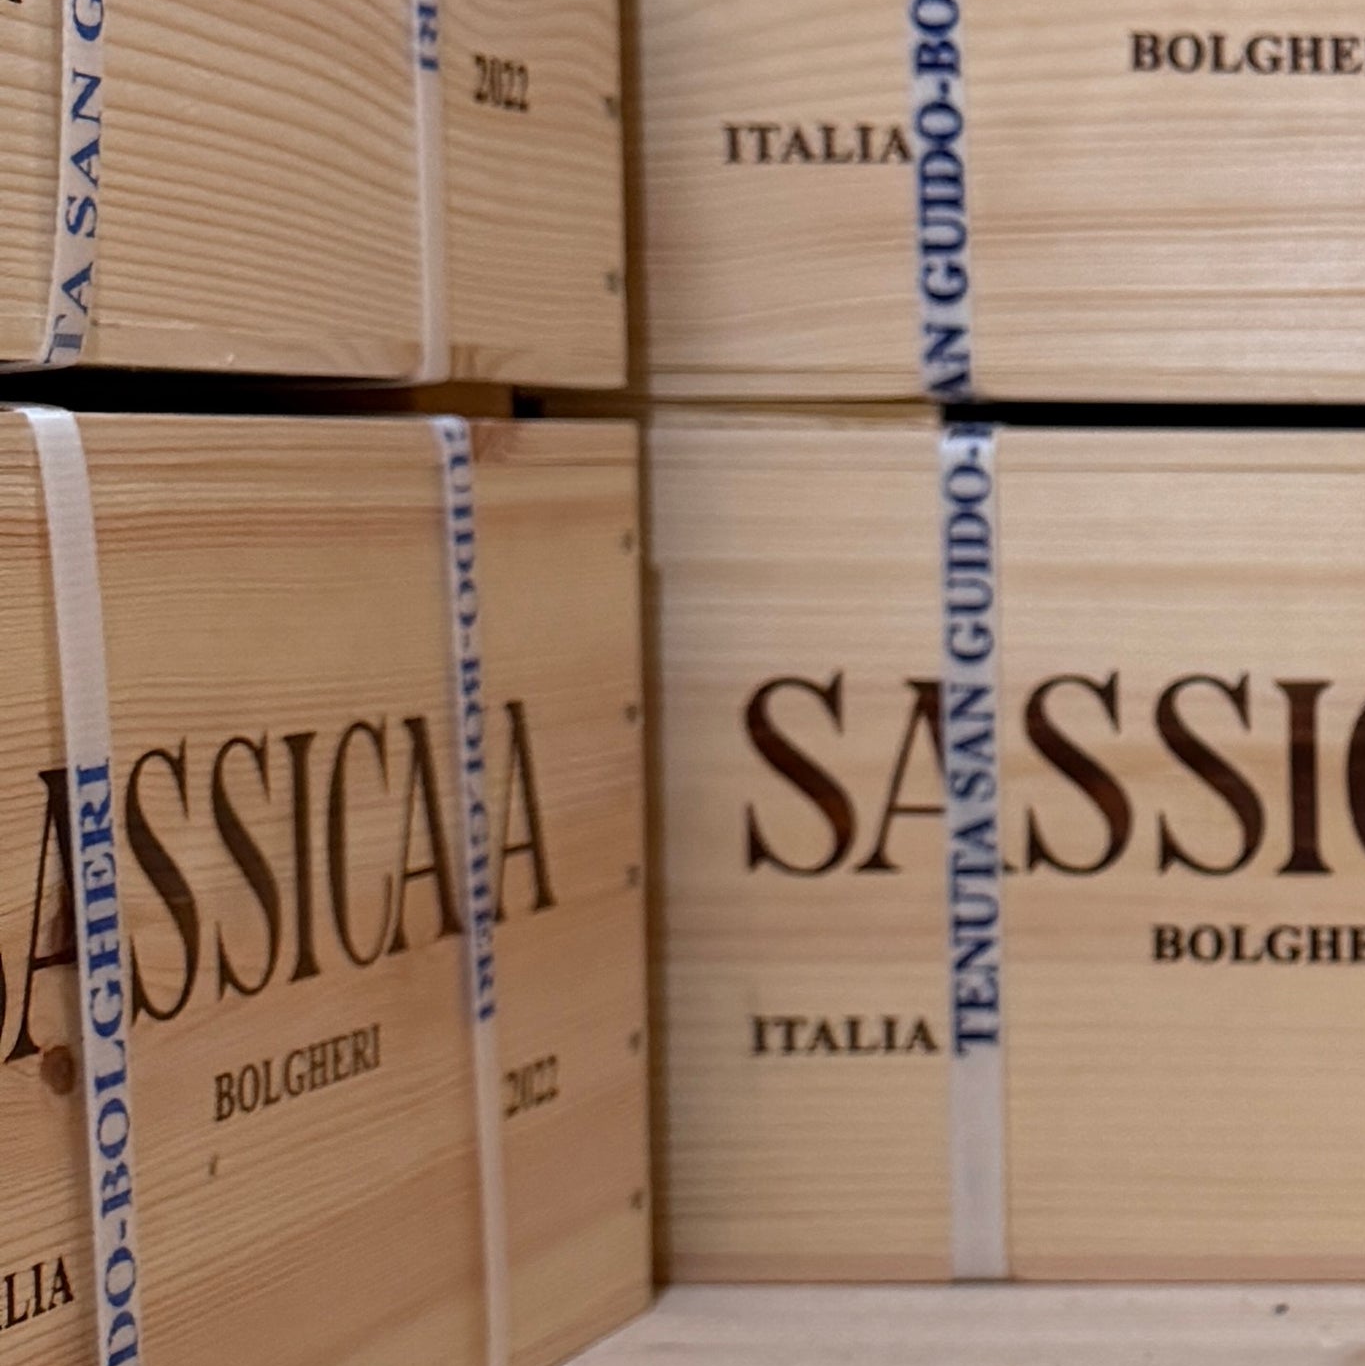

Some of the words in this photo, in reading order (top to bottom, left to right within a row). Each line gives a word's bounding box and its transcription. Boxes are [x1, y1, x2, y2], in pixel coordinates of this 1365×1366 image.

[473, 53, 529, 112] 2022
[66, 68, 101, 238] SAN
[722, 123, 912, 164] ITALIA
[949, 685, 996, 803] SAN
[951, 815, 999, 1056] TENUTA
[213, 1024, 382, 1123] BOLGHERI
[750, 1014, 940, 1056] ITALIA
